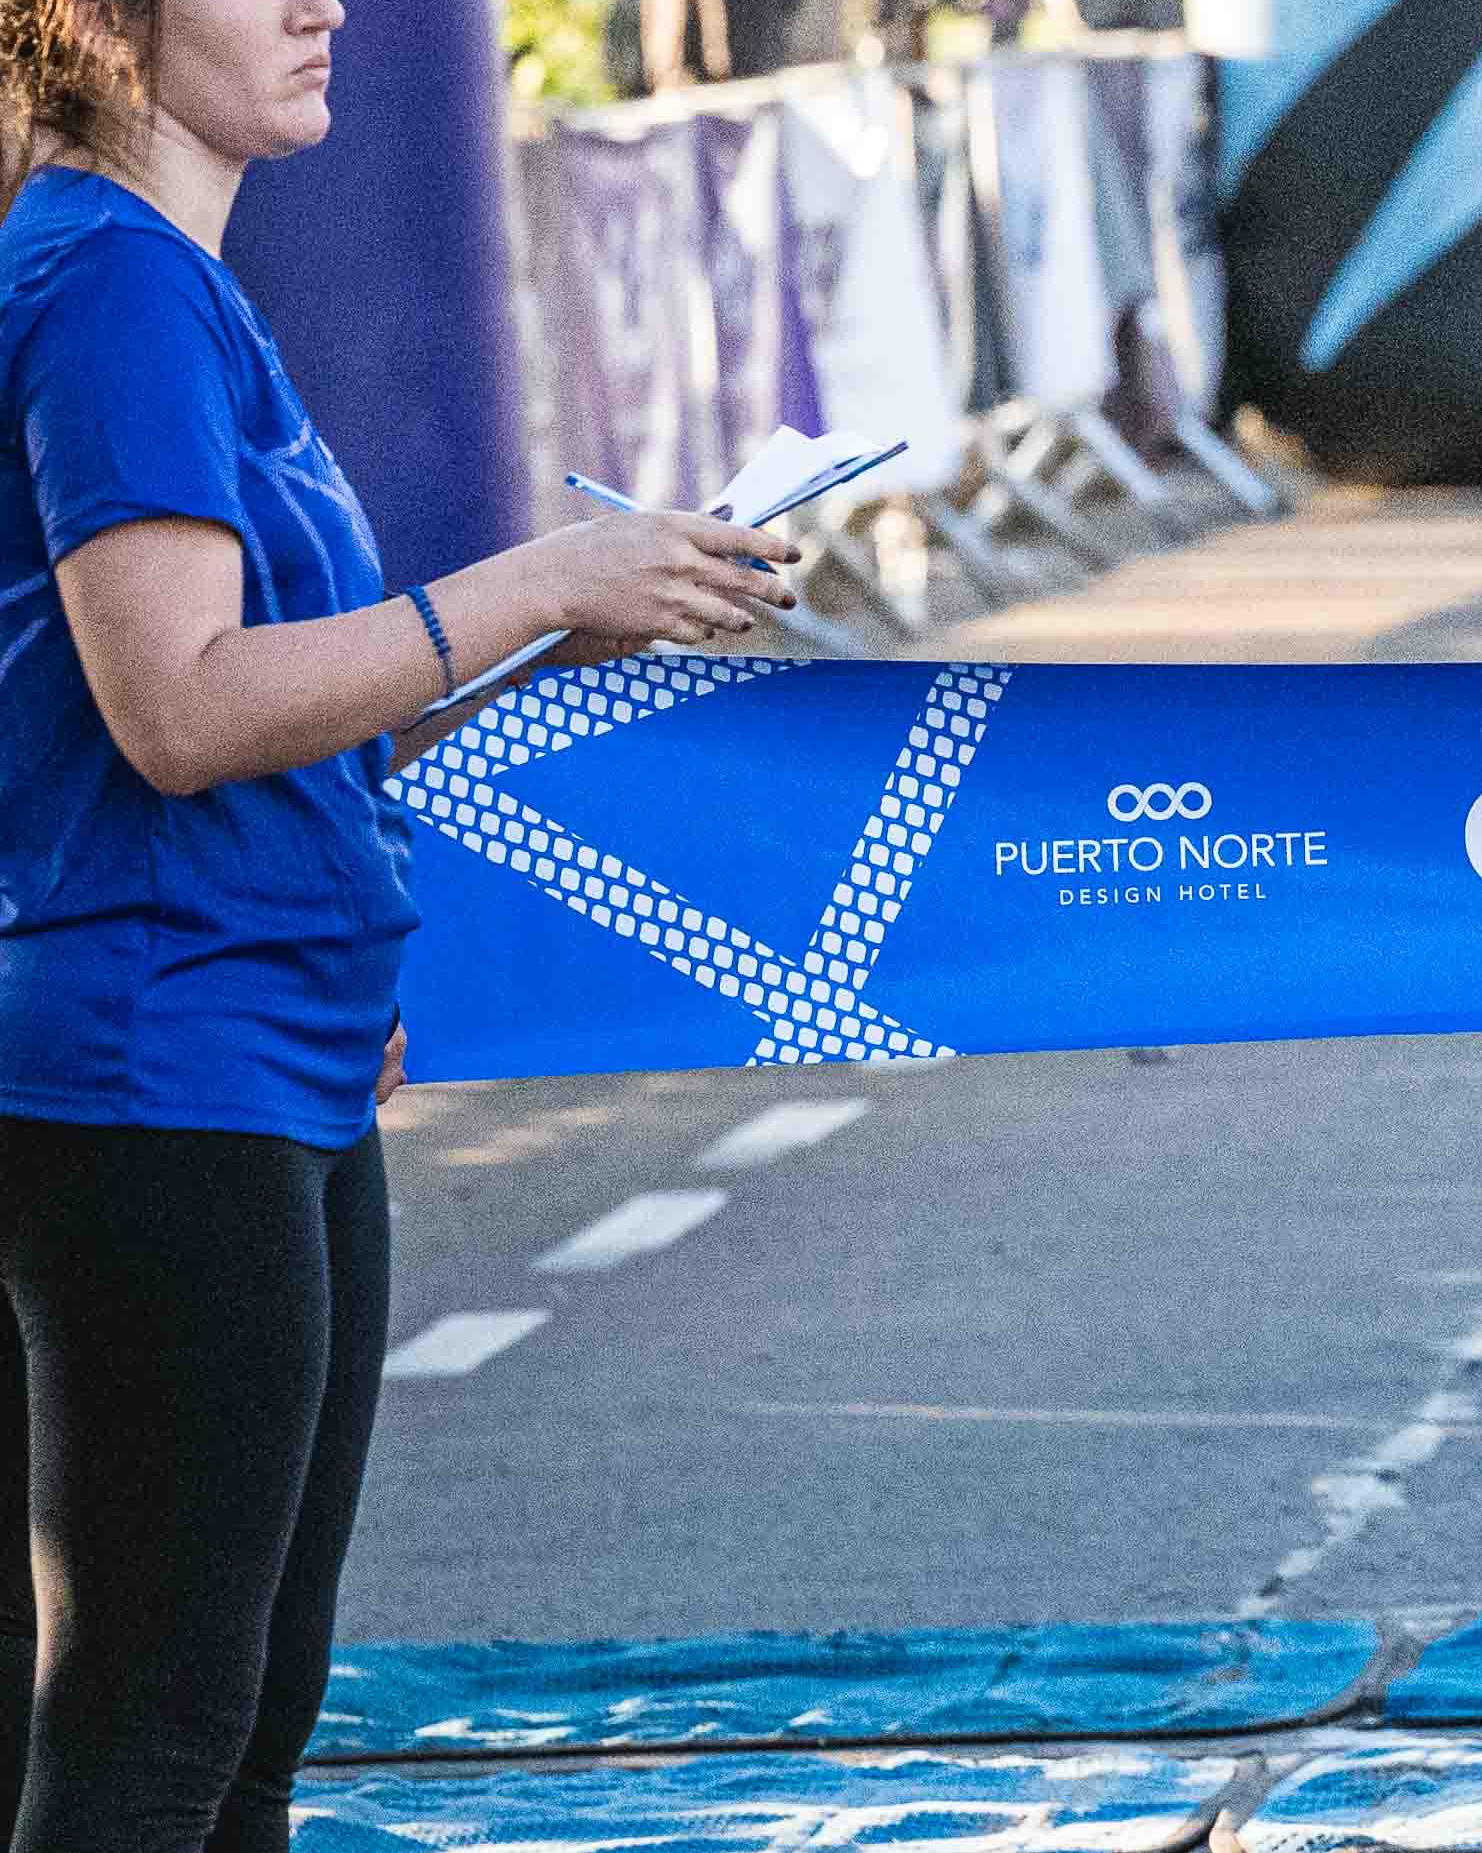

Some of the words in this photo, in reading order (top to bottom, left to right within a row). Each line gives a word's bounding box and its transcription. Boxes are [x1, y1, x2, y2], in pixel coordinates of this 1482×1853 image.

[996, 836, 1164, 876] PUERTO
[1179, 830, 1329, 870] NORTE
[1059, 886, 1162, 906] DESIGN
[1179, 883, 1266, 901] HOTEL
